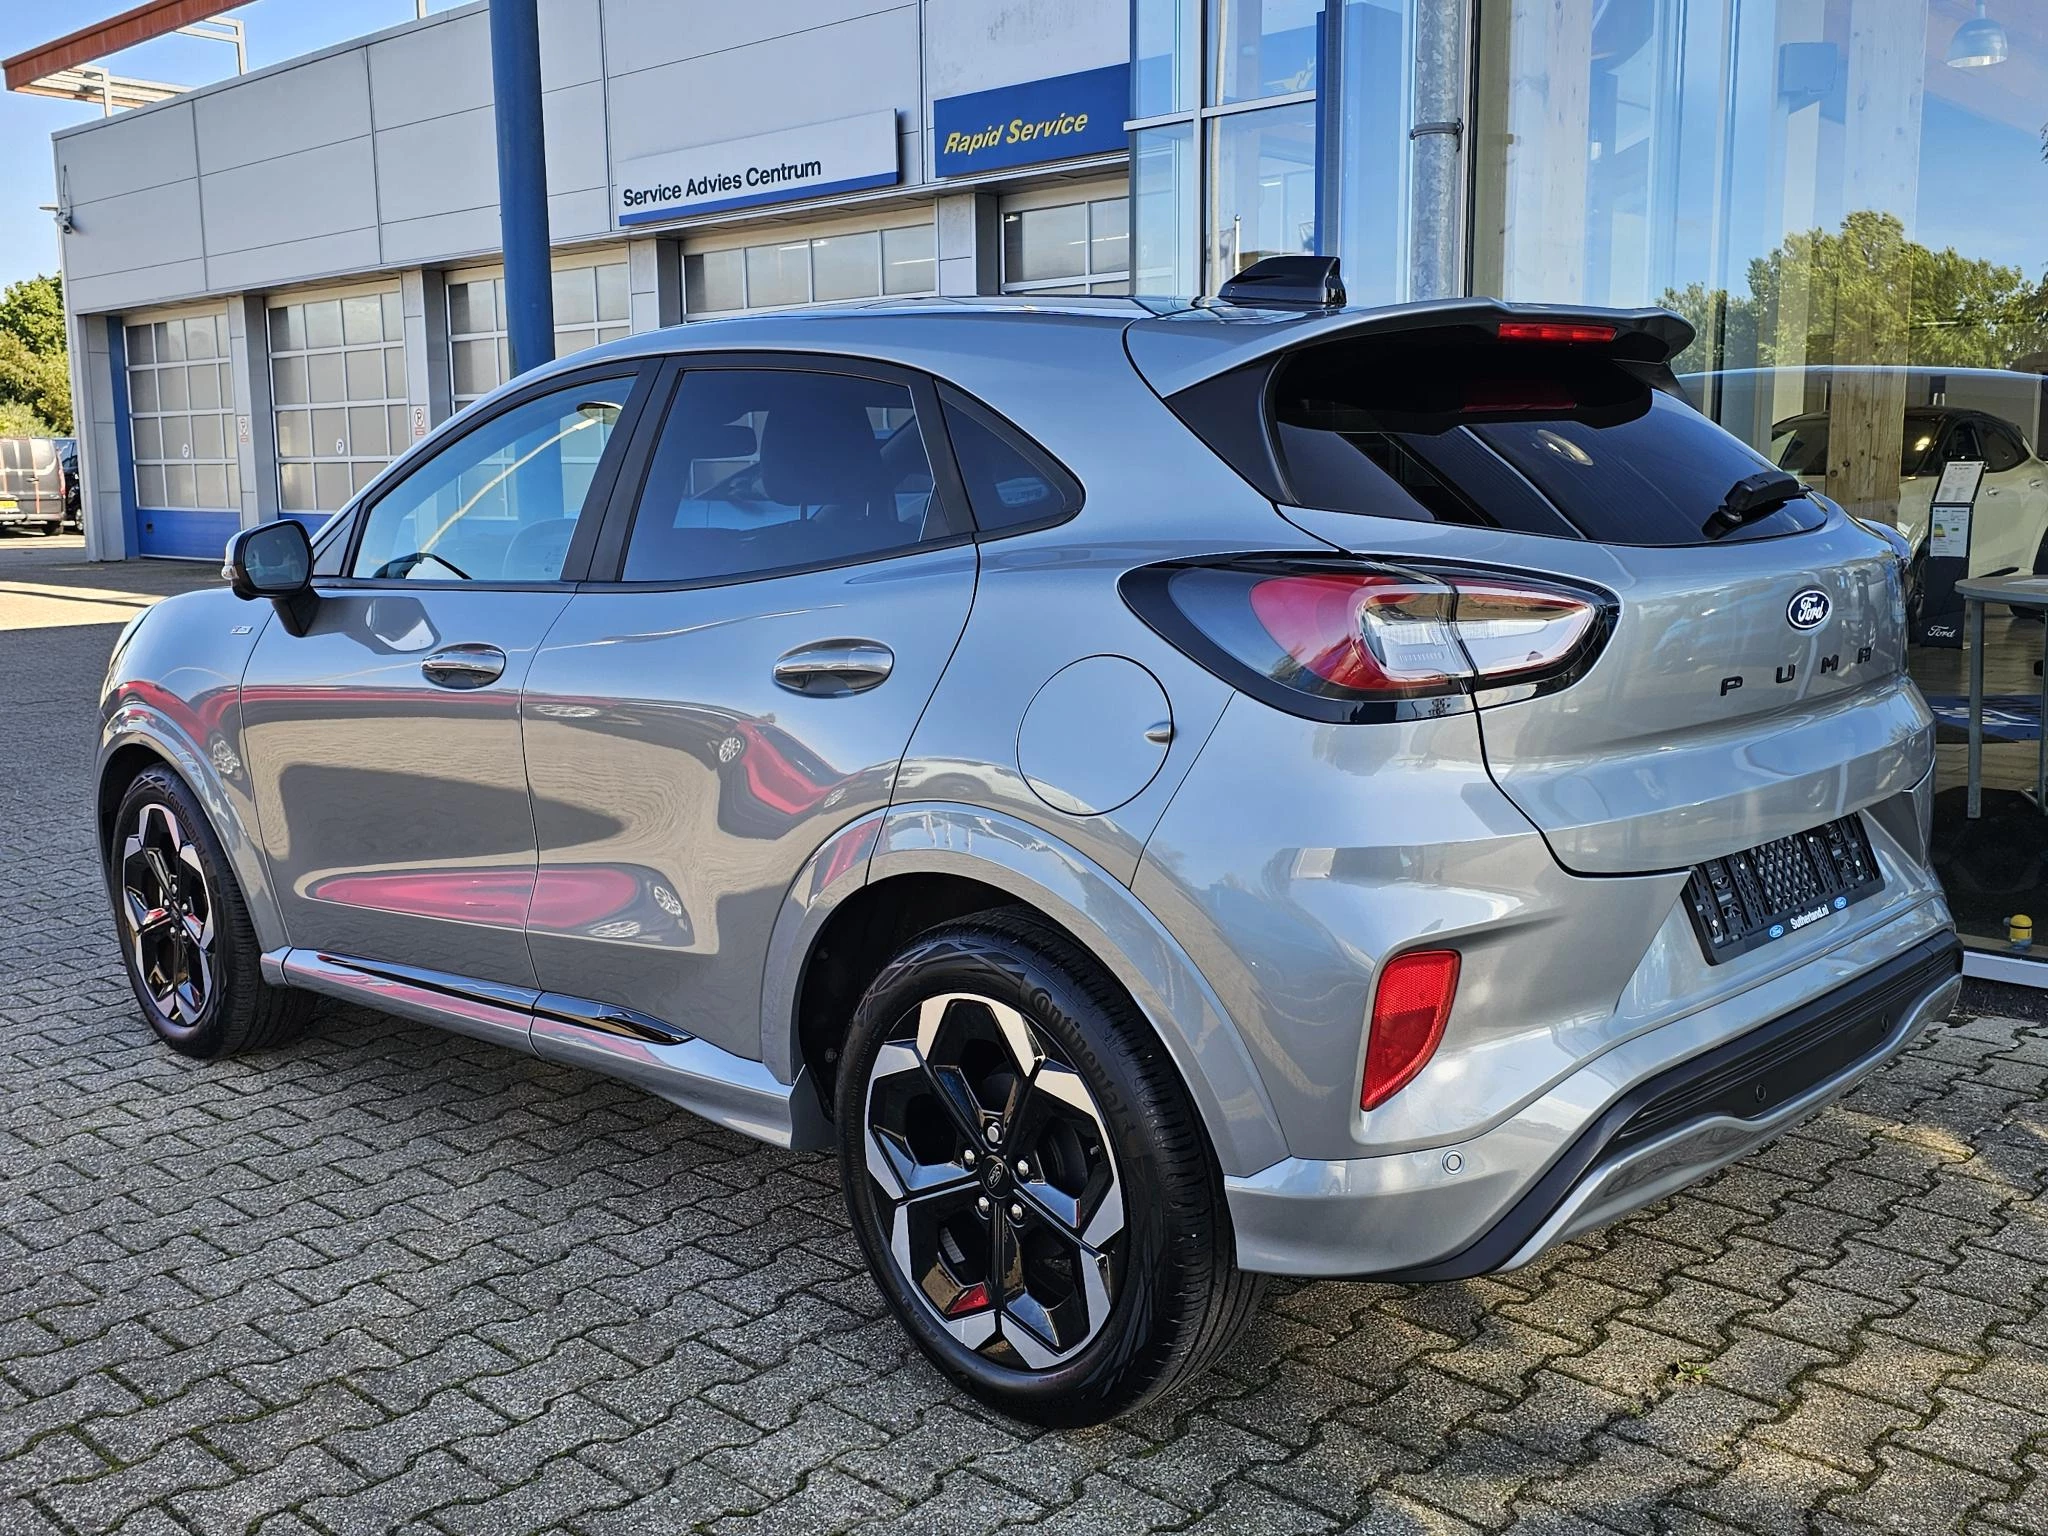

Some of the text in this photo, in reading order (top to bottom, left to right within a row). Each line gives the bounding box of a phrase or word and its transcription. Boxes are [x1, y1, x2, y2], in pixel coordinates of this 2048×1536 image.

[944, 113, 1088, 155] Rapid Service
[623, 160, 821, 207] Service Advies Centrum
[1797, 596, 1824, 621] Ford
[1927, 625, 1957, 638] Ford
[1720, 646, 1872, 696] PUMA
[1029, 987, 1129, 1114] Continental
